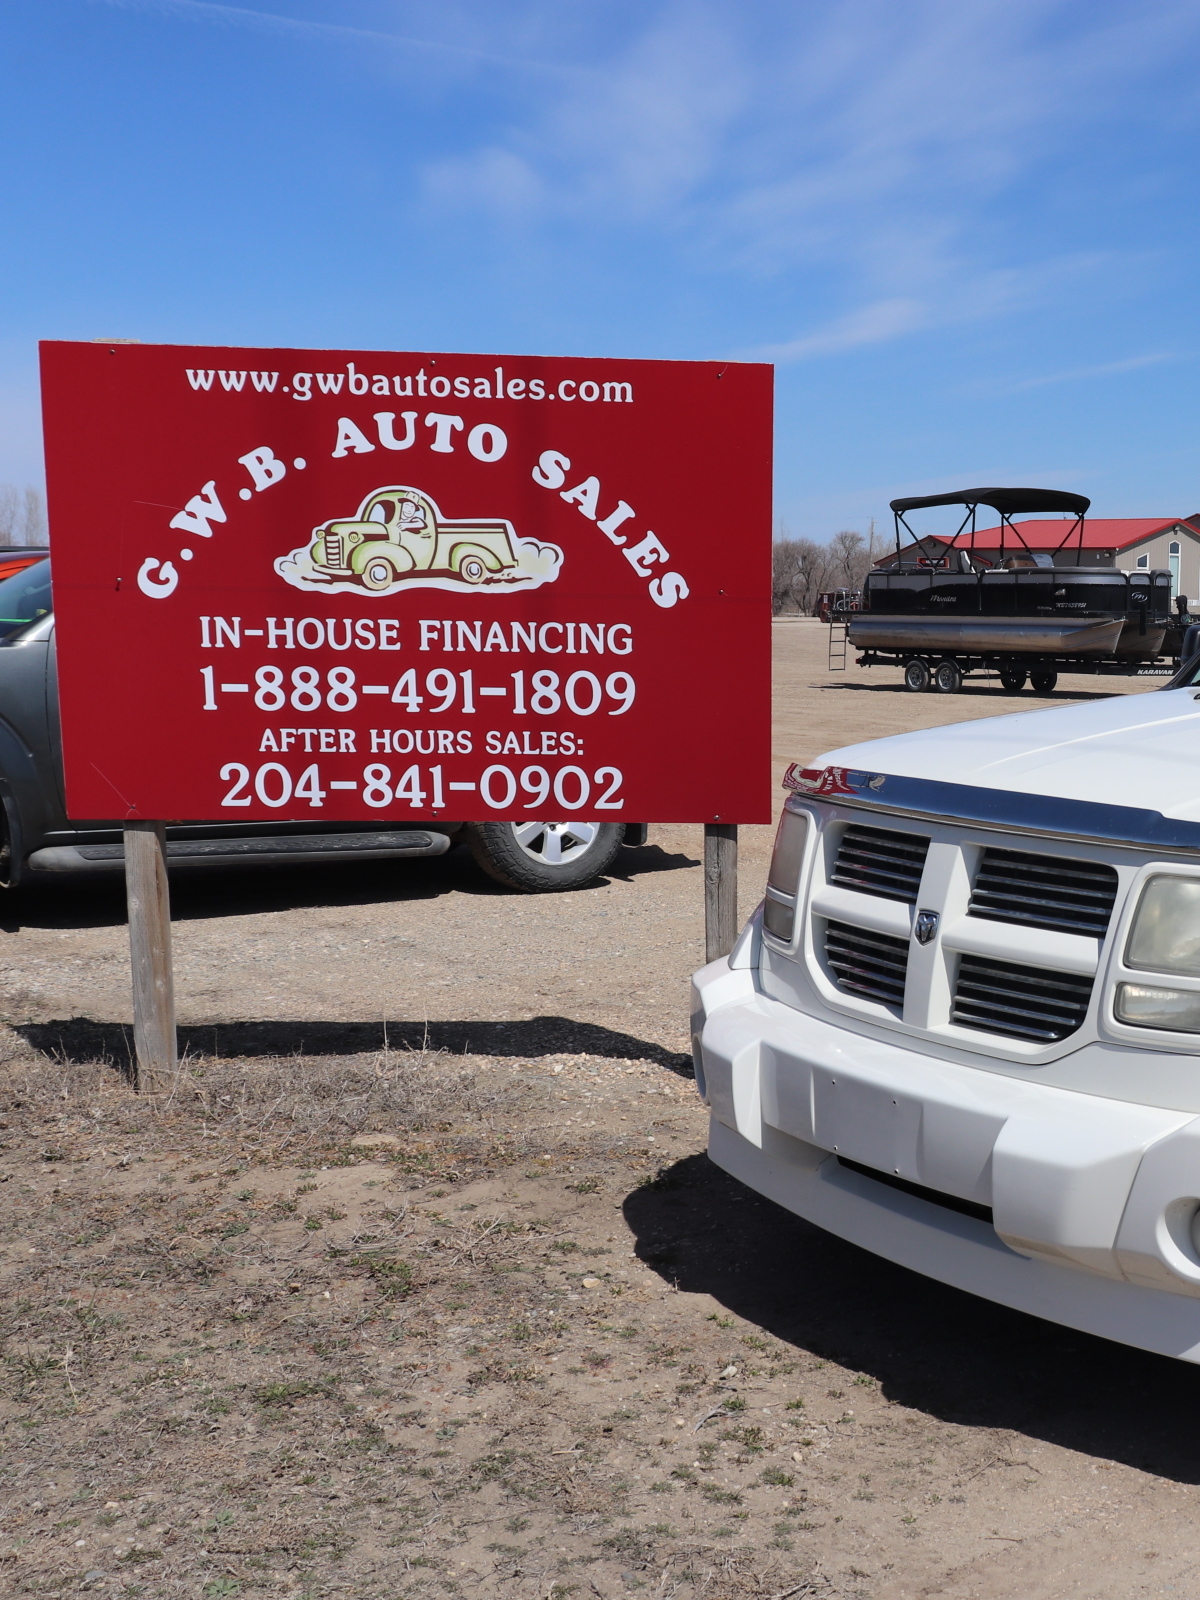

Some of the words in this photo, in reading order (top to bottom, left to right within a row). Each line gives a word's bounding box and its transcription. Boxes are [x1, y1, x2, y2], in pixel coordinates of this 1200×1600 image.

[186, 362, 634, 404] www.gwbautosales.com
[137, 446, 307, 599] G.W.B.
[331, 411, 508, 463] AUTO
[531, 449, 690, 609] SALES
[199, 616, 401, 651] IN-HOUSE
[418, 619, 634, 656] FINANCING
[200, 665, 637, 717] 1-888-491-1809
[258, 728, 358, 754] AFTER
[369, 729, 473, 755] HOURS
[485, 730, 585, 757] SALES:
[219, 762, 625, 811] 204-841-0902
